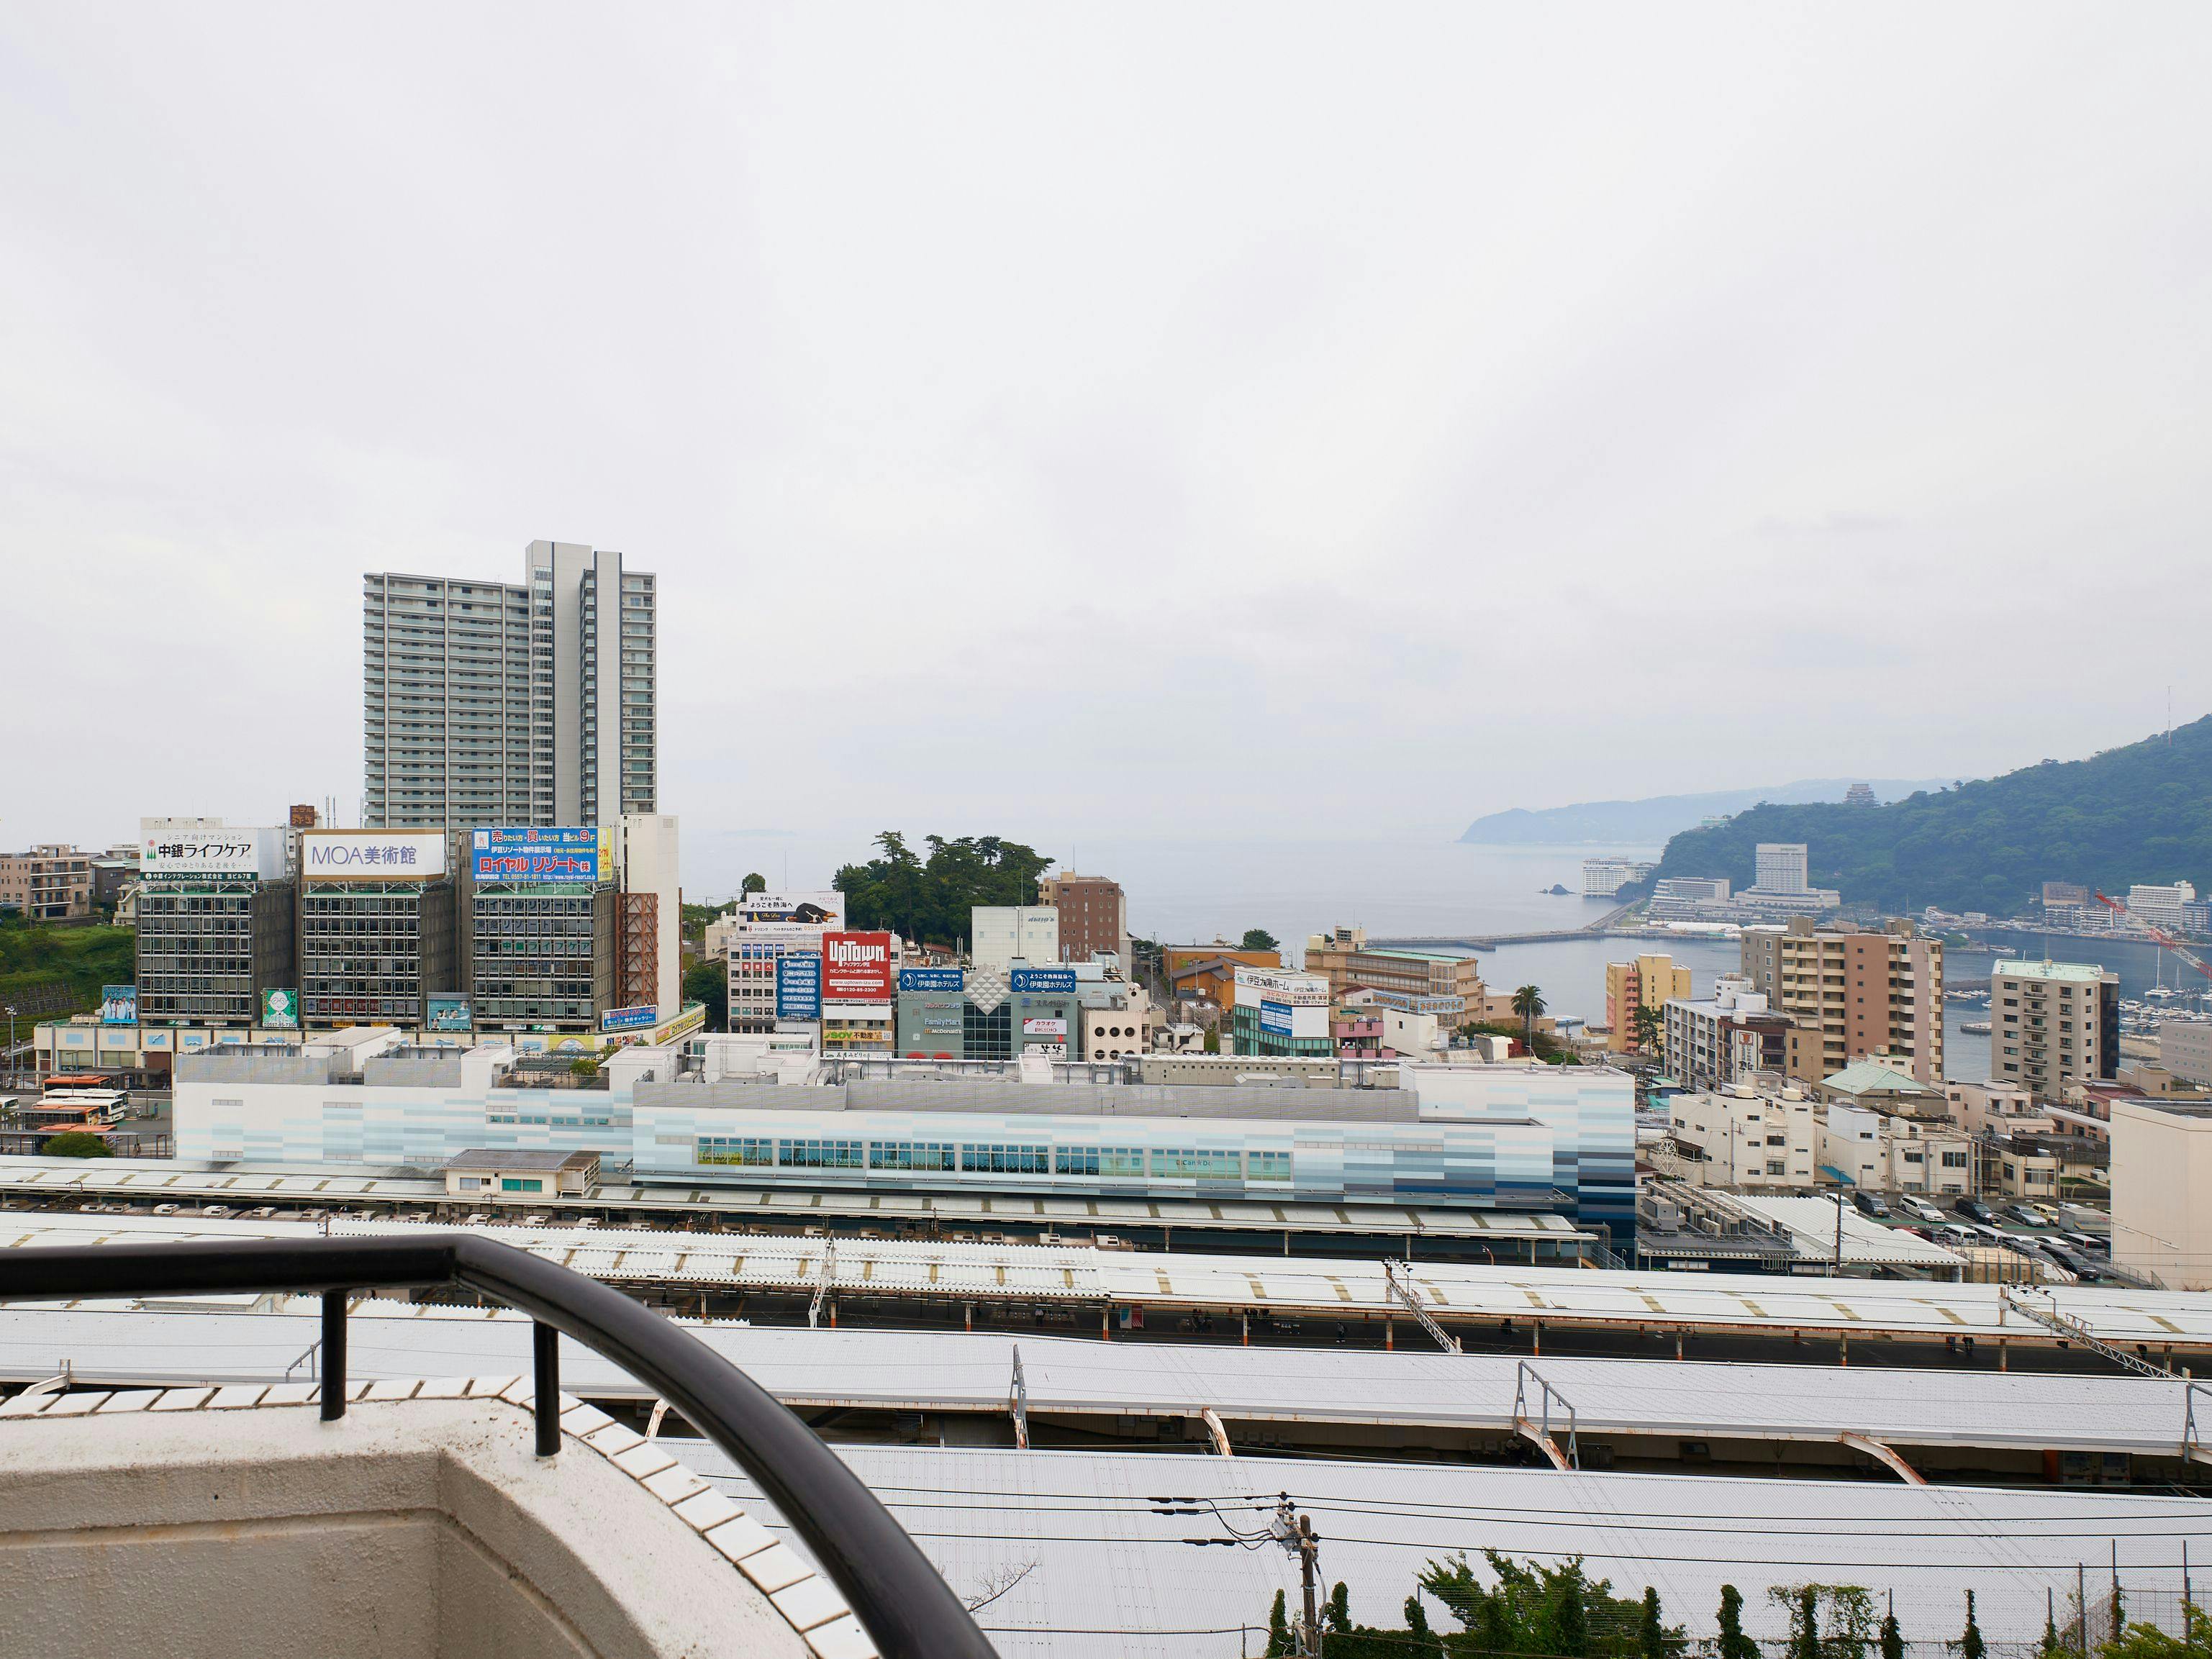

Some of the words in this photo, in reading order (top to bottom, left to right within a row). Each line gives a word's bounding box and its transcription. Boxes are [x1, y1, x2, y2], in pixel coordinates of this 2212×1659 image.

[158, 844, 251, 858] 中銀ライフケア
[312, 845, 417, 864] MOA美術館
[480, 857, 529, 873] ロイヤル
[533, 855, 579, 872] リゾート
[925, 1018, 961, 1027] FamilyMart
